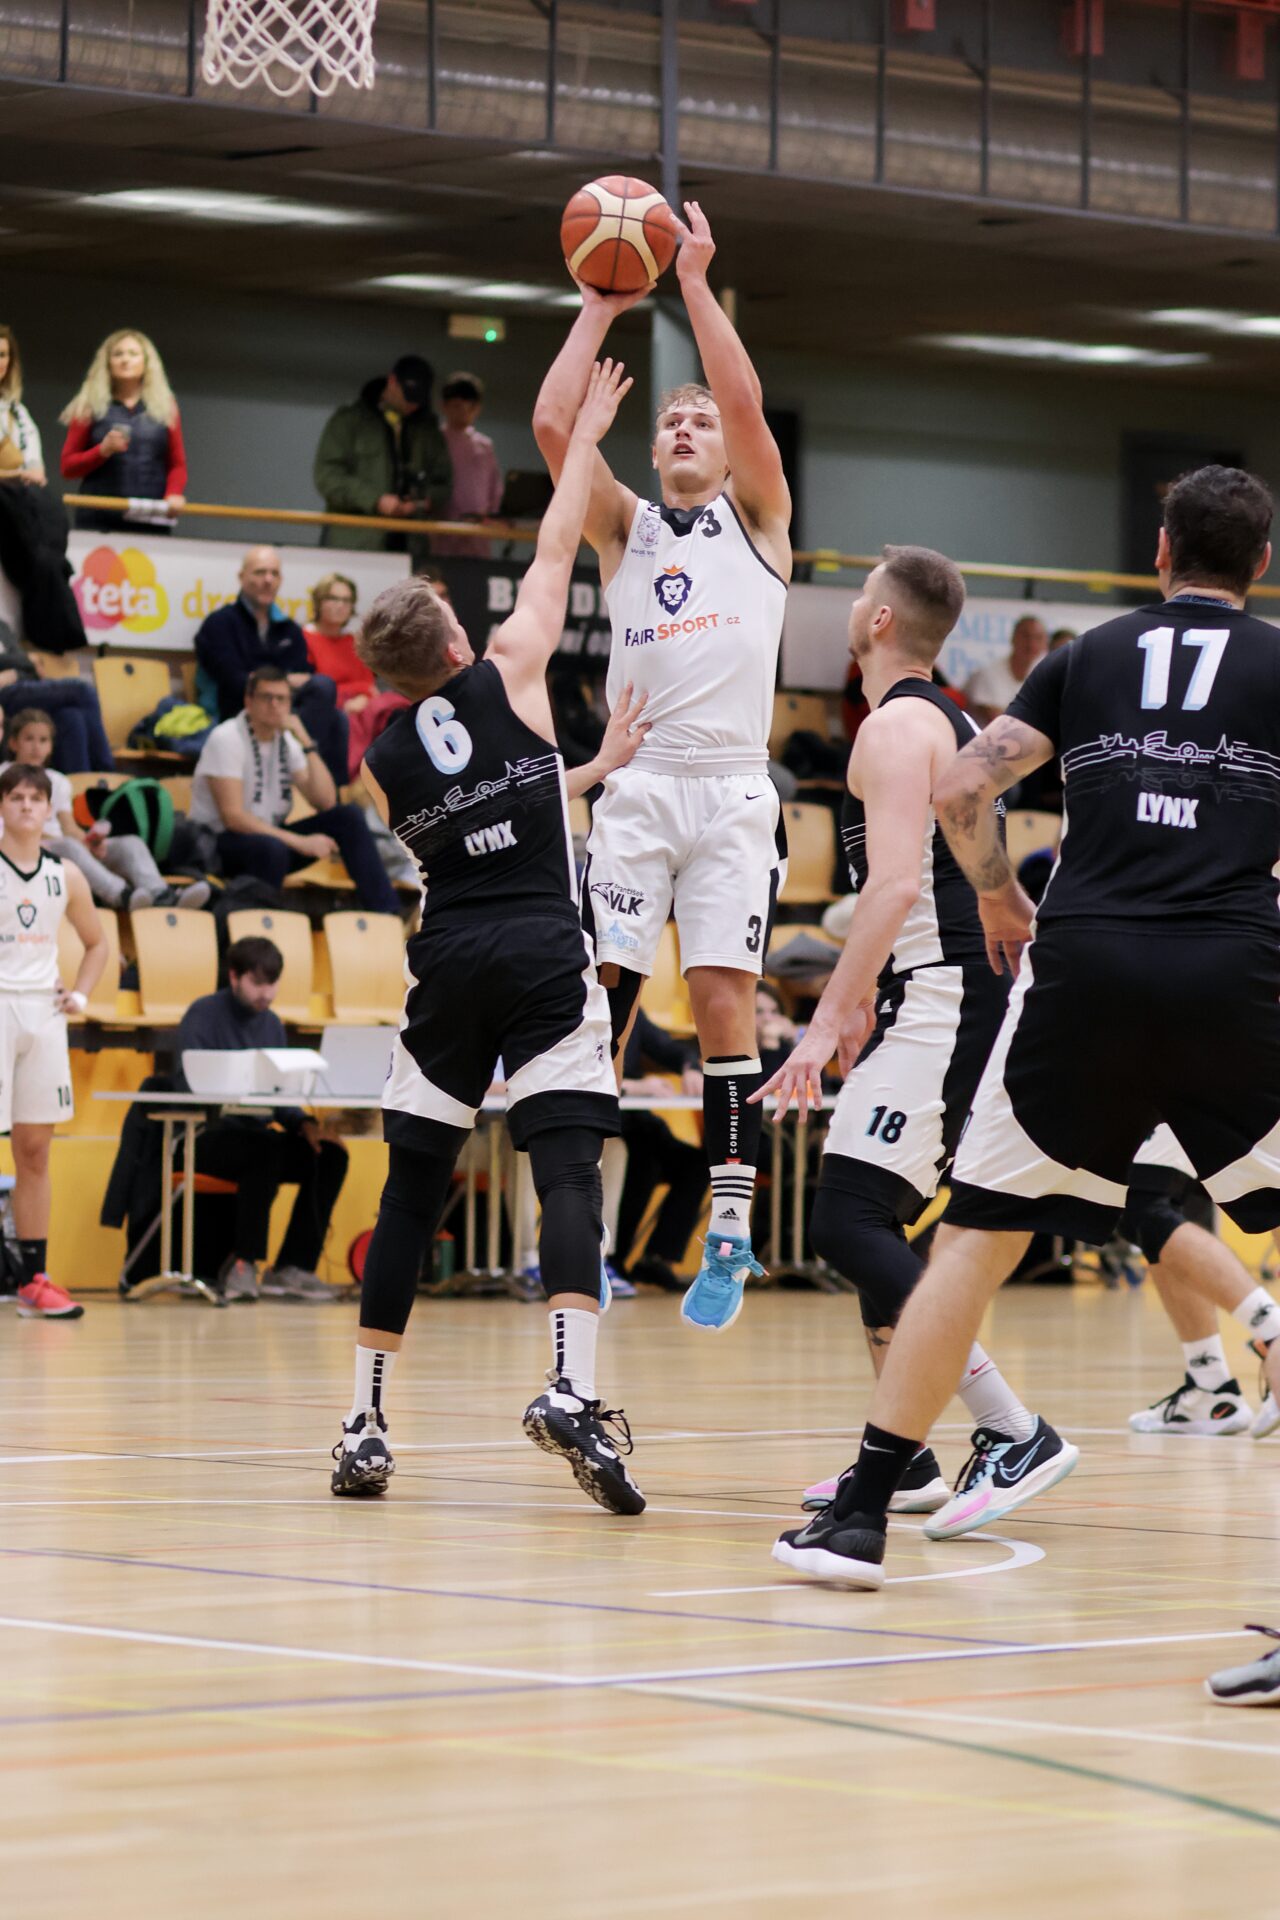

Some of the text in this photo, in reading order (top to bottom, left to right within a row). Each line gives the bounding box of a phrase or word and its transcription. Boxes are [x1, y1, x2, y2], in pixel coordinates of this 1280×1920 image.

[698, 508, 722, 538] 3
[81, 575, 158, 617] teta
[1137, 626, 1231, 711] 17
[415, 696, 473, 775] 6
[1136, 792, 1199, 829] LYNX
[464, 820, 518, 857] LYNX
[45, 873, 62, 897] 10
[609, 889, 645, 917] VLK
[745, 914, 762, 953] 3
[58, 1084, 71, 1108] 10
[728, 1080, 739, 1154] COMPRESSPORT
[865, 1104, 908, 1145] 18
